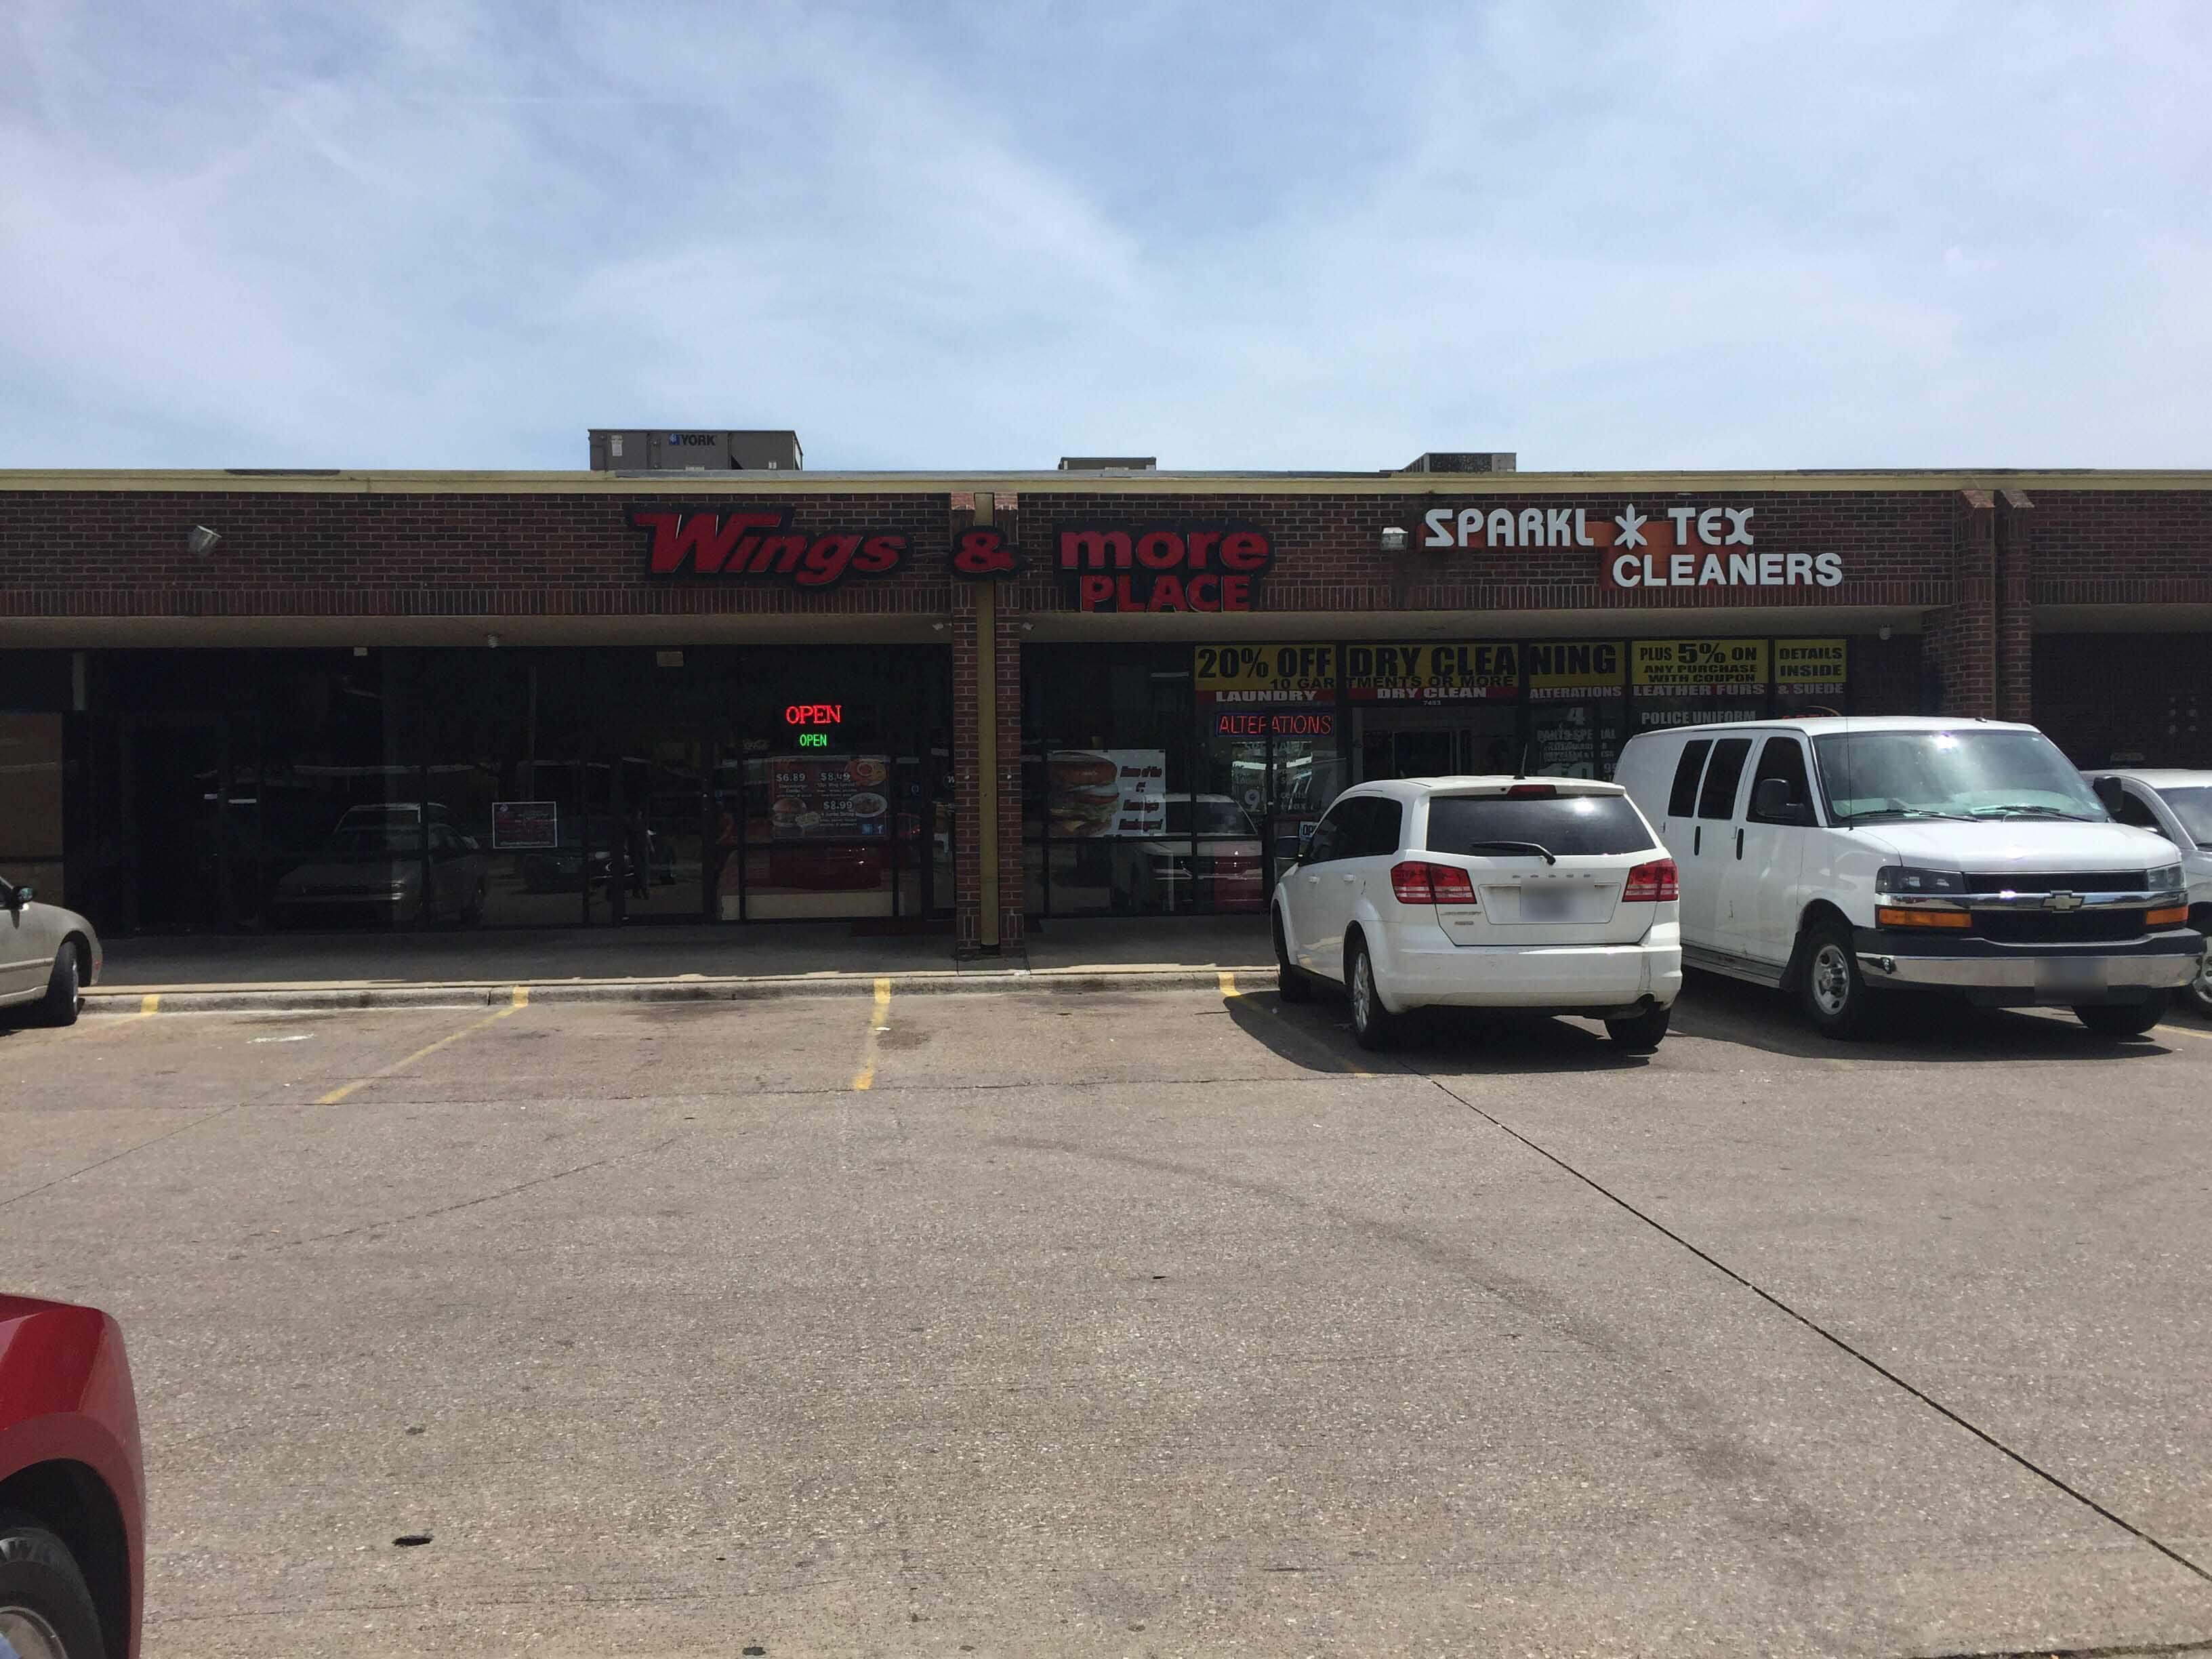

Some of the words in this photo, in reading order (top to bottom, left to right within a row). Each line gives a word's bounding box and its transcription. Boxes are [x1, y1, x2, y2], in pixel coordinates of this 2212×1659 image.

[680, 434, 716, 445] YORK
[1425, 508, 1595, 547] SPARKL
[1668, 507, 1755, 546] TEX
[634, 512, 907, 586] Wings
[953, 532, 1016, 573] &
[1060, 531, 1269, 570] more
[1612, 552, 1843, 588] CLEANERS
[1080, 574, 1252, 613] PLACE
[1639, 647, 1673, 661] PLUS
[1678, 643, 1726, 663] 5%
[1732, 647, 1757, 661] ON
[1779, 647, 1843, 660] DETAILS
[1197, 647, 1269, 678] 20%
[1277, 647, 1332, 677] OFF
[1349, 647, 1421, 676] DRY
[1644, 665, 1674, 673] ANY
[1677, 664, 1757, 673] PURCHASE
[1780, 665, 1842, 676] INSIDE
[1270, 678, 1290, 689] 10
[1429, 676, 1454, 687] OR
[1460, 676, 1514, 687] MORE
[1648, 674, 1689, 682] WITH
[1693, 674, 1755, 682] COUPON
[1377, 688, 1418, 699] DRY
[1423, 687, 1486, 699] CLEAN
[1529, 687, 1622, 699] ALTERATIONS
[1633, 684, 1712, 696] LEATHER
[1717, 683, 1766, 695] FURS
[1778, 683, 1790, 695] &
[1792, 683, 1844, 695] SUEDE
[1215, 690, 1317, 702] LAUNDRY
[784, 704, 841, 725] OPEN
[1641, 711, 1690, 724] POLICE
[1692, 710, 1757, 724] UNIFORM
[799, 733, 827, 747] OPEN
[823, 800, 853, 810] $8.99
